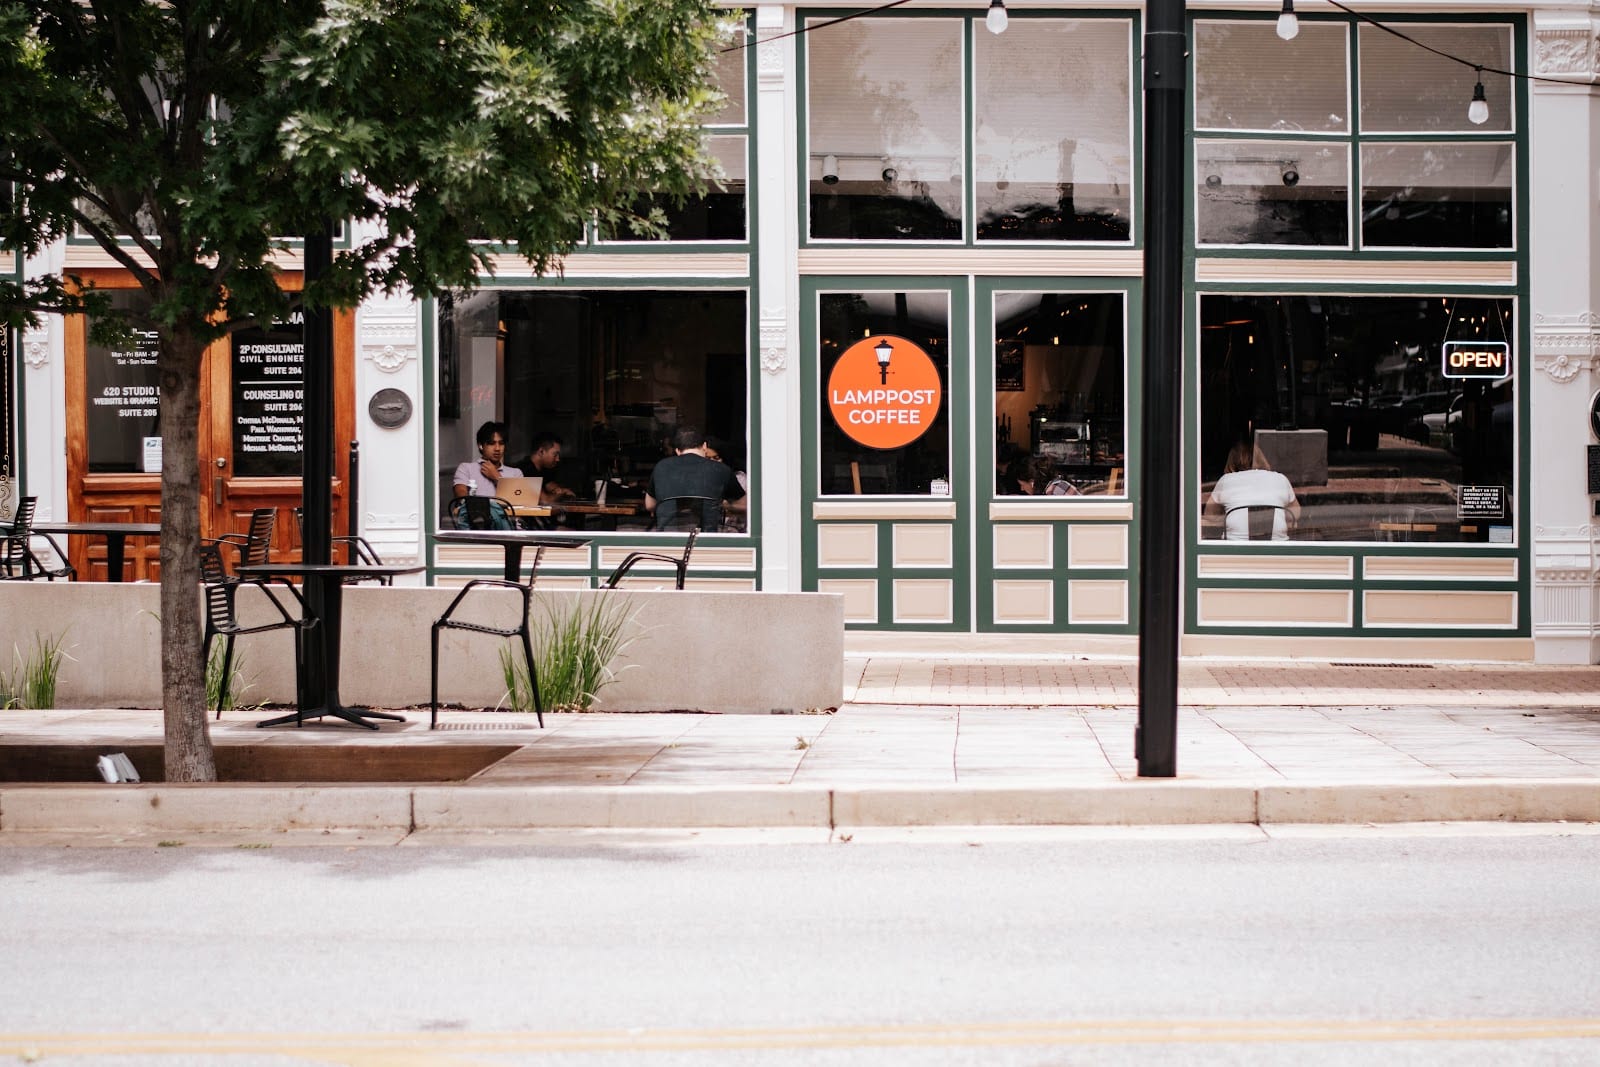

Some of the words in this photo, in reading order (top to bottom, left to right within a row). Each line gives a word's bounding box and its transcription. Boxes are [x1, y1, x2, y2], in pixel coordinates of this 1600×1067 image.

[239, 344, 250, 354] 2P
[265, 354, 304, 363] ENGINEE
[1450, 351, 1502, 368] OPEN
[263, 366, 287, 375] SUITE
[103, 387, 120, 396] 620
[122, 386, 154, 396] STUDIO
[243, 390, 294, 400] COUNSELING
[833, 389, 936, 405] LAMPPOST
[143, 408, 157, 417] 205
[848, 409, 920, 424] COFFEE
